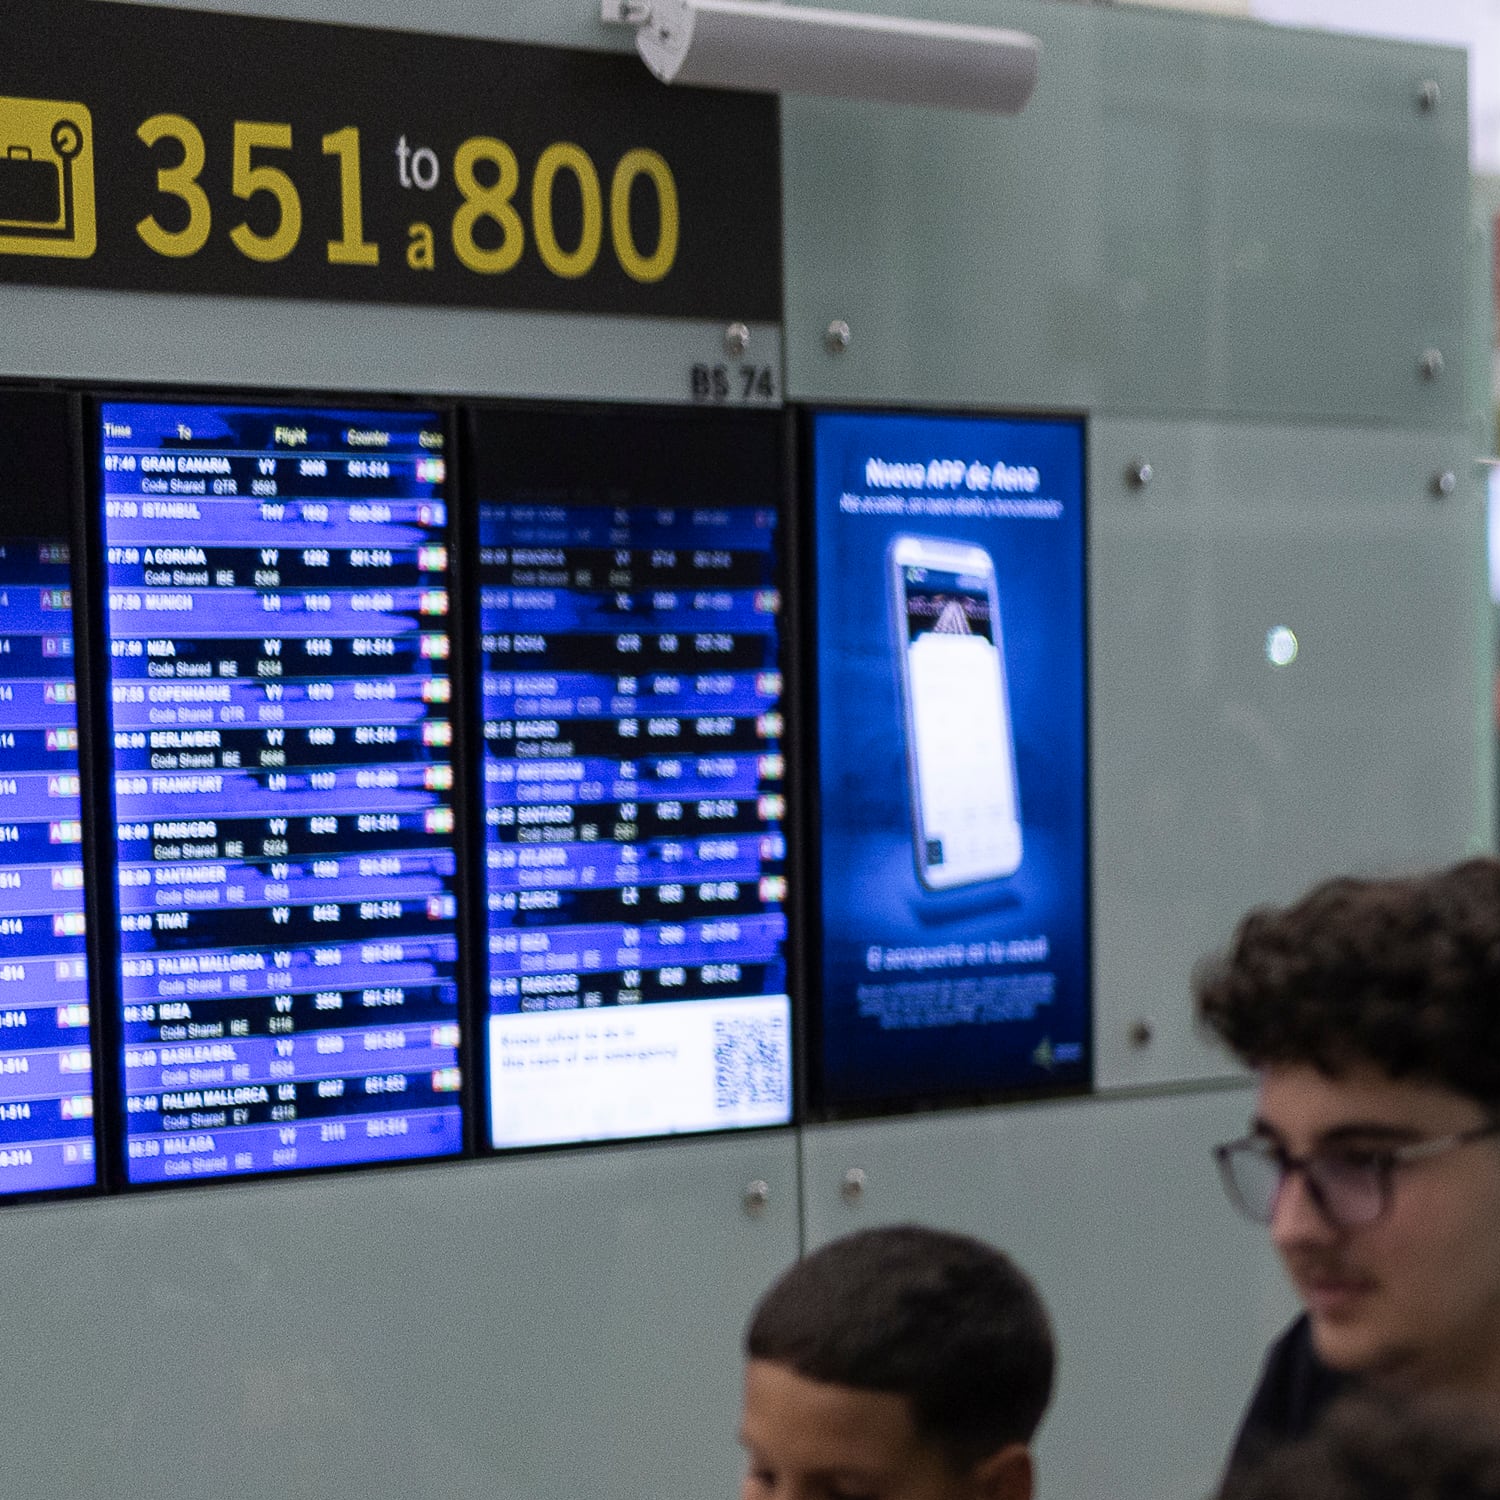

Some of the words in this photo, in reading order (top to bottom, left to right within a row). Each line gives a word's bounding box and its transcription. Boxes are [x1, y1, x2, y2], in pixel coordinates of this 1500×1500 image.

[136, 113, 380, 266] 351
[397, 136, 441, 190] to
[452, 136, 681, 284] 800
[406, 223, 436, 271] a
[691, 364, 732, 399] BS
[741, 367, 777, 400] 74
[104, 423, 131, 437] Time
[177, 424, 192, 440] To
[275, 427, 306, 445] Flight
[141, 457, 176, 471] GRAN
[177, 457, 230, 473] CANARIA
[259, 459, 275, 474] VY
[141, 478, 168, 494] Code
[170, 479, 205, 495] Shared
[142, 502, 200, 518] ISTANBUL
[144, 548, 154, 563] A
[155, 546, 206, 564] CORUÑA
[261, 549, 278, 565] VY
[145, 571, 171, 586] Code
[173, 571, 208, 586] Shared
[145, 594, 192, 610] MUNICH
[147, 641, 175, 656] NIZA
[264, 639, 280, 655] VY
[148, 663, 174, 678] Code
[176, 662, 211, 678] Shared
[267, 729, 283, 745] VY
[151, 754, 178, 769] Code
[179, 753, 214, 767] Shared
[151, 775, 222, 792] FRANKFURT
[270, 819, 286, 834] VY
[154, 845, 180, 860] Code
[182, 844, 217, 859] Shared
[155, 866, 226, 883] SANTANDER
[273, 907, 289, 923] VY
[158, 958, 199, 974] PALMA
[199, 954, 264, 972] MALLORCA
[275, 996, 291, 1012] VY
[160, 1025, 186, 1040] Code
[188, 1023, 223, 1038] Shared
[162, 1091, 203, 1109] PALMA
[203, 1087, 268, 1106] MALLORCA
[163, 1115, 190, 1131] Code
[191, 1113, 226, 1129] Shared
